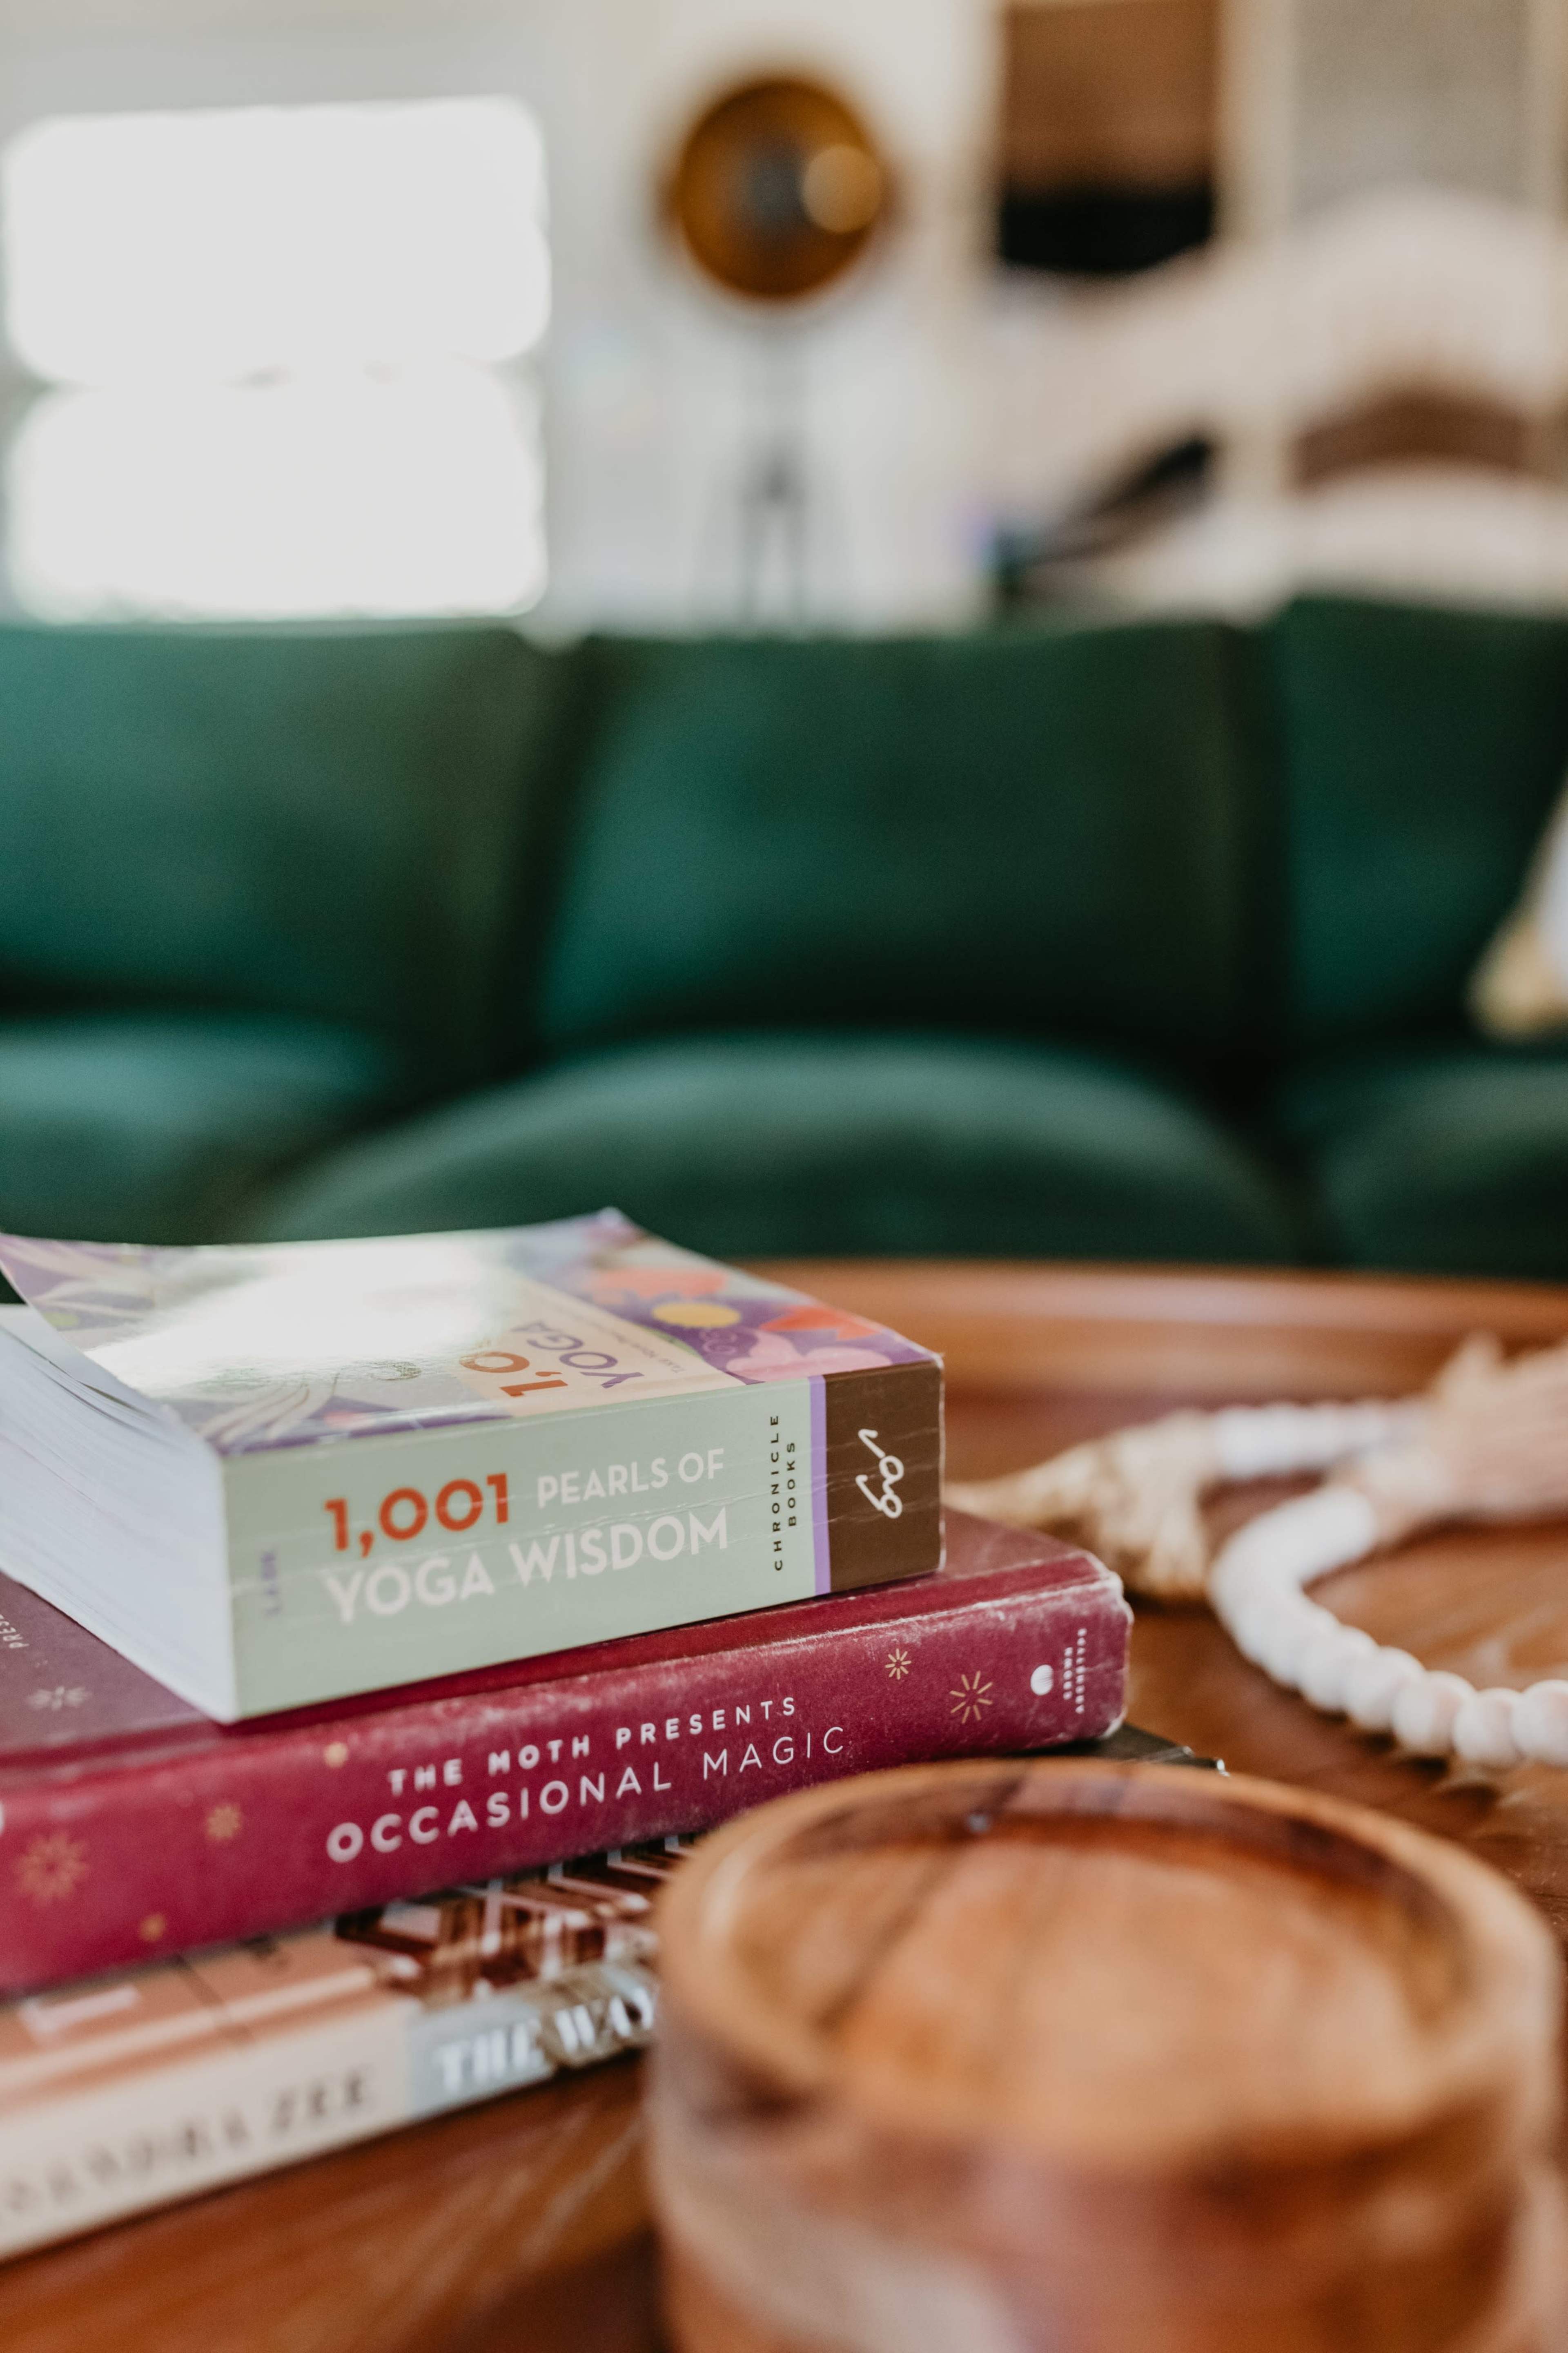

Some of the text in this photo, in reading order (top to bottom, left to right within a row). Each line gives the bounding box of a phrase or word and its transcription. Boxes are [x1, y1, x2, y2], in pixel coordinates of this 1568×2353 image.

[510, 1320, 644, 1389] YOGA
[325, 1448, 725, 1557] 1,001 PEARLS OF
[770, 1416, 783, 1571] CHRONICLE
[786, 1442, 797, 1527] BOOKS
[325, 1553, 495, 1624] YOGA
[509, 1507, 728, 1588] WISDOM
[326, 1726, 844, 1863] OCCASIONAL MAGIC
[388, 1697, 796, 1795] THE MOTH PRESENTS
